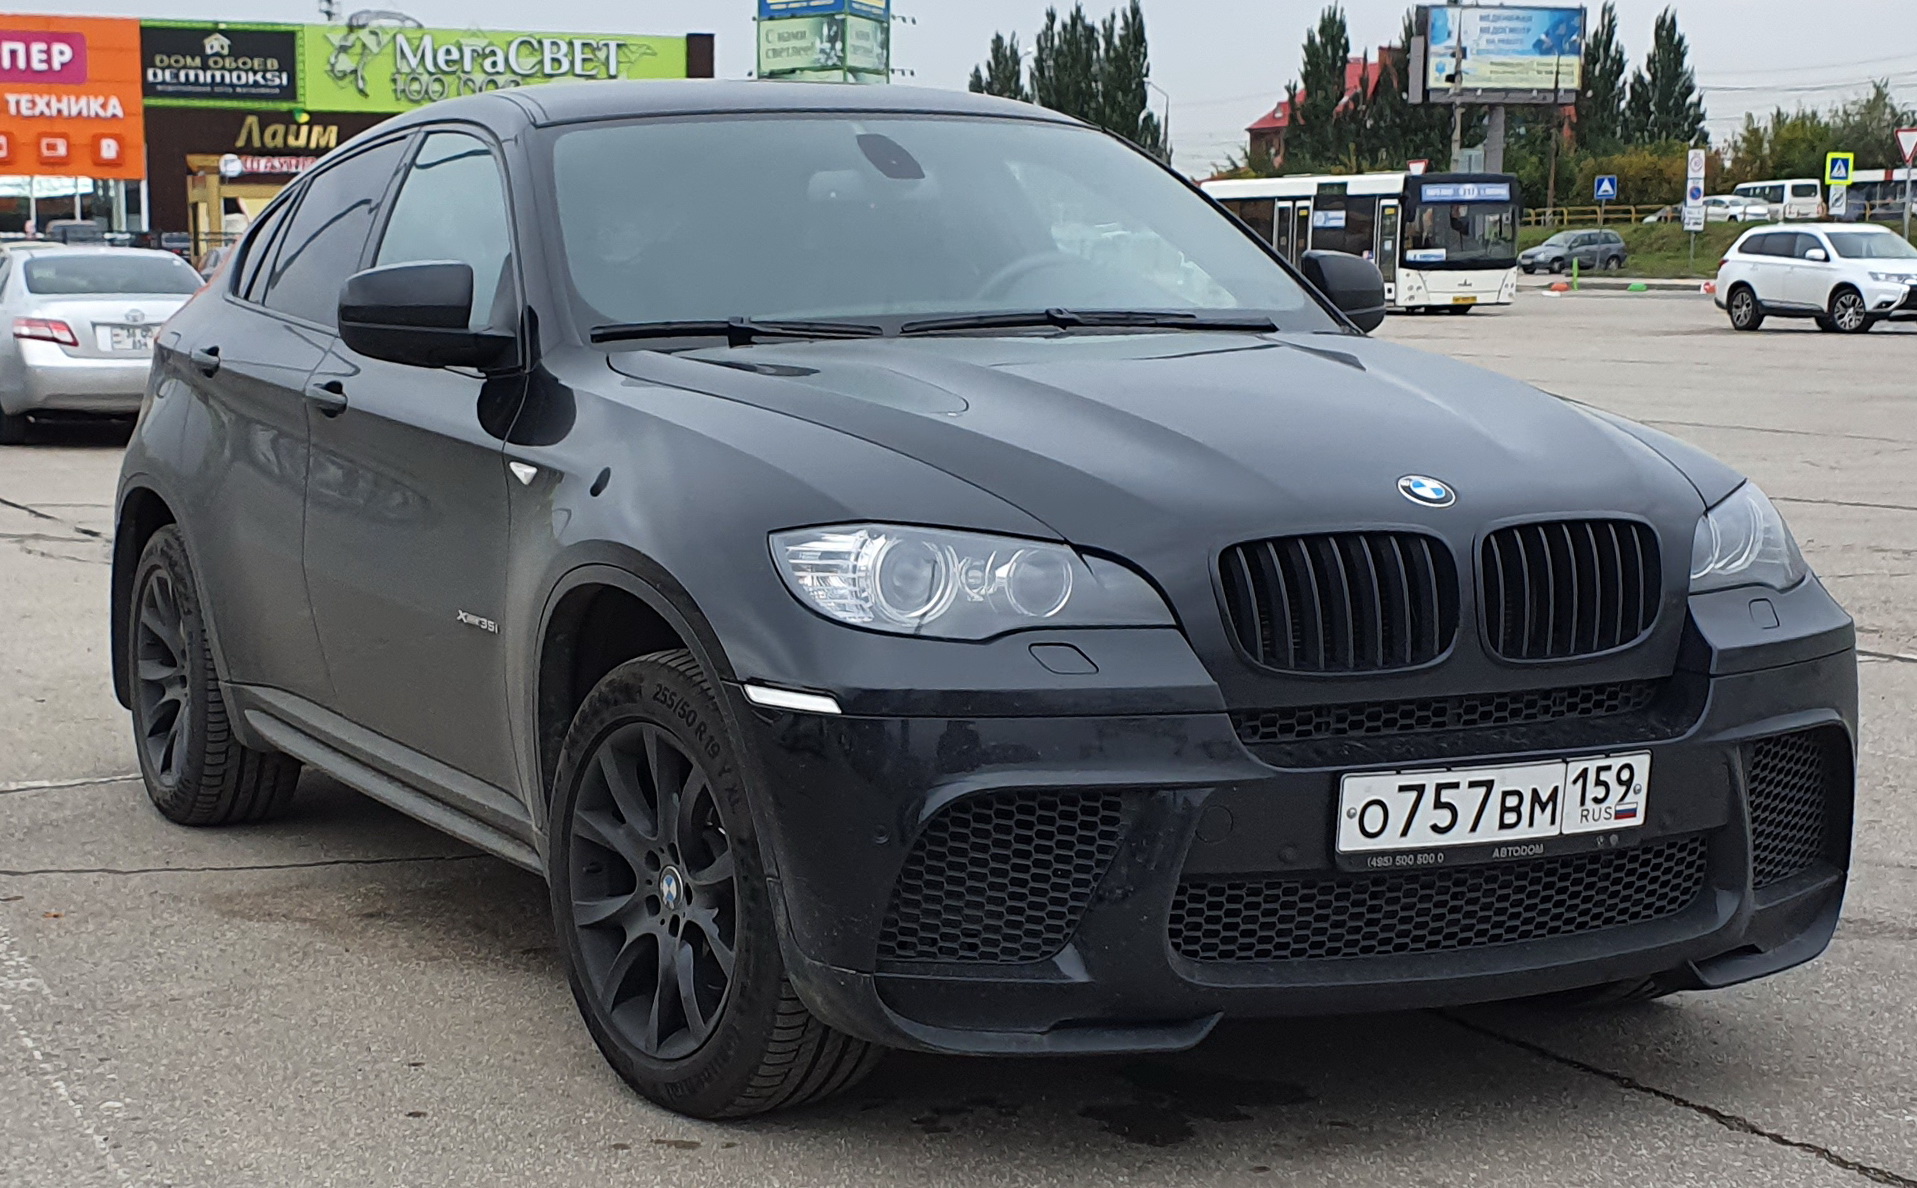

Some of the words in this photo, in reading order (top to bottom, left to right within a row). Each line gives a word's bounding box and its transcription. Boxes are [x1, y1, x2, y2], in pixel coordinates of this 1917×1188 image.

[1, 41, 74, 72] ПЕР
[395, 32, 626, 78] МегаСВЕТ
[4, 92, 124, 119] ТЕХНИКА
[235, 109, 339, 149] Лайм
[652, 683, 698, 727] 255/50
[1571, 762, 1636, 808] 159
[1579, 806, 1613, 823] RUS
